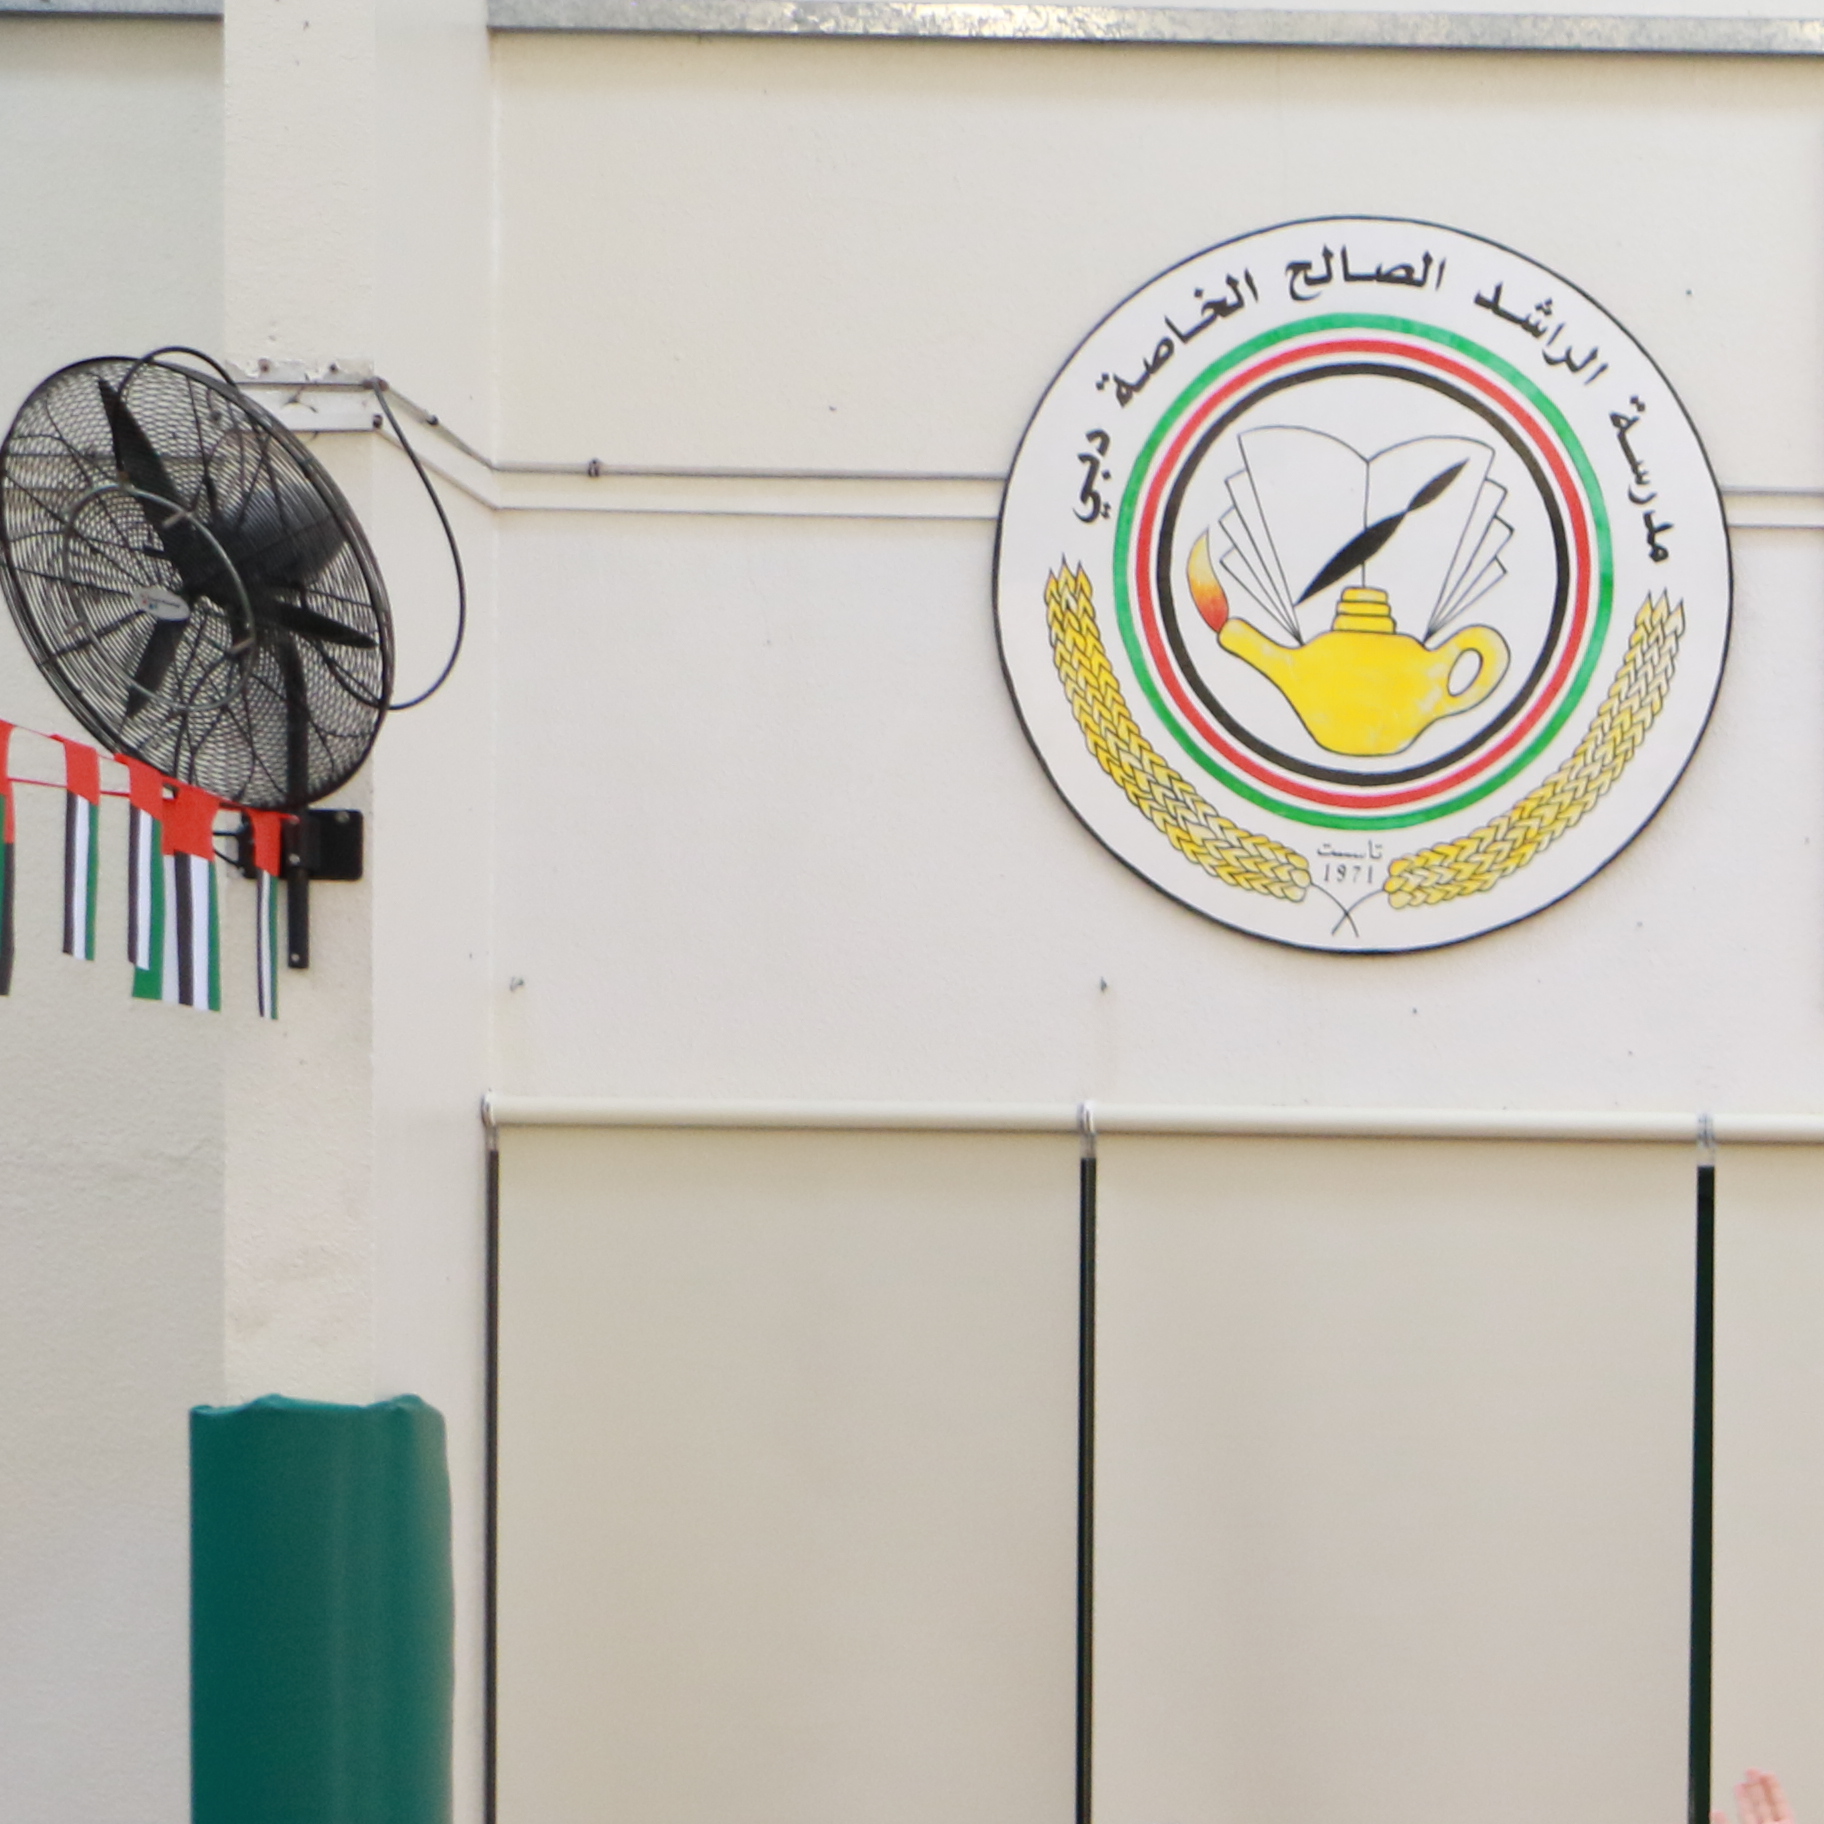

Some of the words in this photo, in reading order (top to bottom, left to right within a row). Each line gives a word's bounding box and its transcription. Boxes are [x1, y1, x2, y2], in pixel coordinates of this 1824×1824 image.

[1284, 243, 1446, 301] الصالح
[1095, 267, 1260, 408] الخاصة
[1473, 280, 1609, 386] الراشد
[1072, 428, 1112, 524] دبي
[1608, 394, 1675, 563] مدرسة
[1323, 863, 1373, 884] 1971
